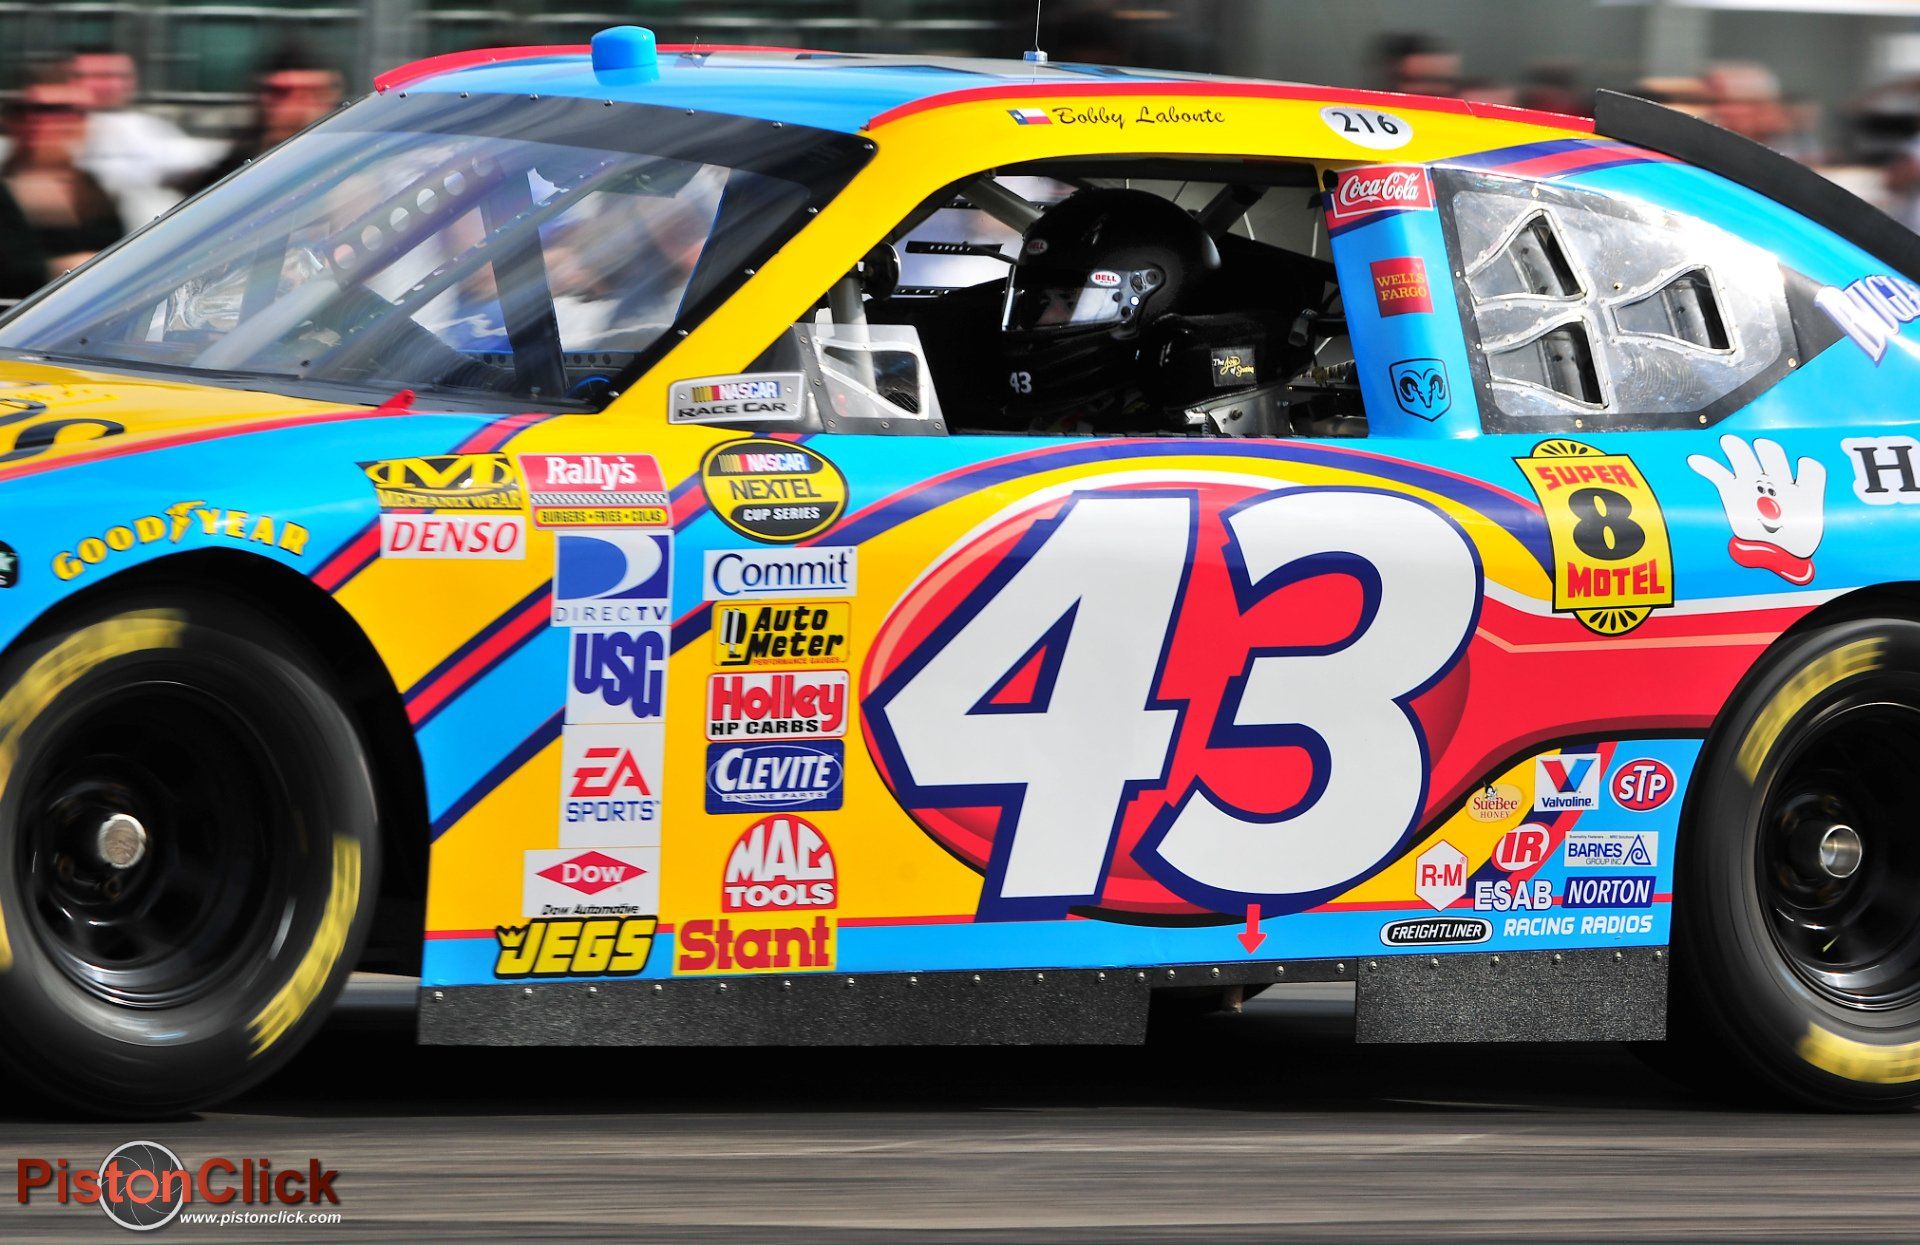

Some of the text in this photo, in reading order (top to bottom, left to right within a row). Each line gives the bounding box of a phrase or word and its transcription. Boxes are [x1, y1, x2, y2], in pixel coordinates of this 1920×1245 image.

[1052, 106, 1225, 130] Bobby Labonte
[1331, 112, 1398, 135] 216
[1340, 171, 1419, 206] Coca-Cola
[1094, 273, 1117, 282] BELL
[1376, 272, 1425, 287] WELLS
[1381, 286, 1427, 300] FARGO
[718, 381, 780, 400] NASCAR
[1009, 371, 1032, 394] 43
[679, 402, 787, 417] RACE CAR
[545, 456, 639, 491] Rally's
[744, 453, 811, 472] NASCAR
[730, 478, 821, 500] NEXTEL
[1535, 464, 1638, 491] SUPER
[543, 511, 586, 522] BURGERS
[594, 511, 622, 522] FRIES
[743, 507, 820, 521] CUP SERIES
[1568, 487, 1646, 560] 8
[390, 521, 519, 552] DENSO
[713, 553, 848, 596] Commit
[1566, 559, 1665, 598] MOTEL
[555, 606, 667, 622] DIRECTV
[753, 606, 828, 632] Auto
[749, 632, 844, 658] Meter
[574, 631, 664, 719] USG
[712, 675, 844, 732] Holley
[866, 486, 1483, 920] 43
[711, 719, 818, 735] HP CARBS
[570, 748, 651, 797] EA
[715, 748, 834, 791] CLEVITE
[726, 791, 823, 800] ENGINE PARTS
[1618, 765, 1667, 803] STP
[566, 801, 654, 822] SPORTS
[1541, 796, 1591, 808] Valvoline
[725, 819, 834, 883] MAC
[1501, 831, 1544, 862] IR
[1568, 843, 1622, 857] BARNES
[1421, 864, 1462, 887] R-M
[724, 883, 835, 907] TOOLS
[1474, 880, 1552, 911] ESAB
[1568, 880, 1650, 904] NORTON
[1391, 924, 1482, 940] FREIGHTLINER
[1503, 915, 1653, 936] RACING RADIOS
[495, 917, 656, 978] JEGS
[679, 916, 829, 971] Stant
